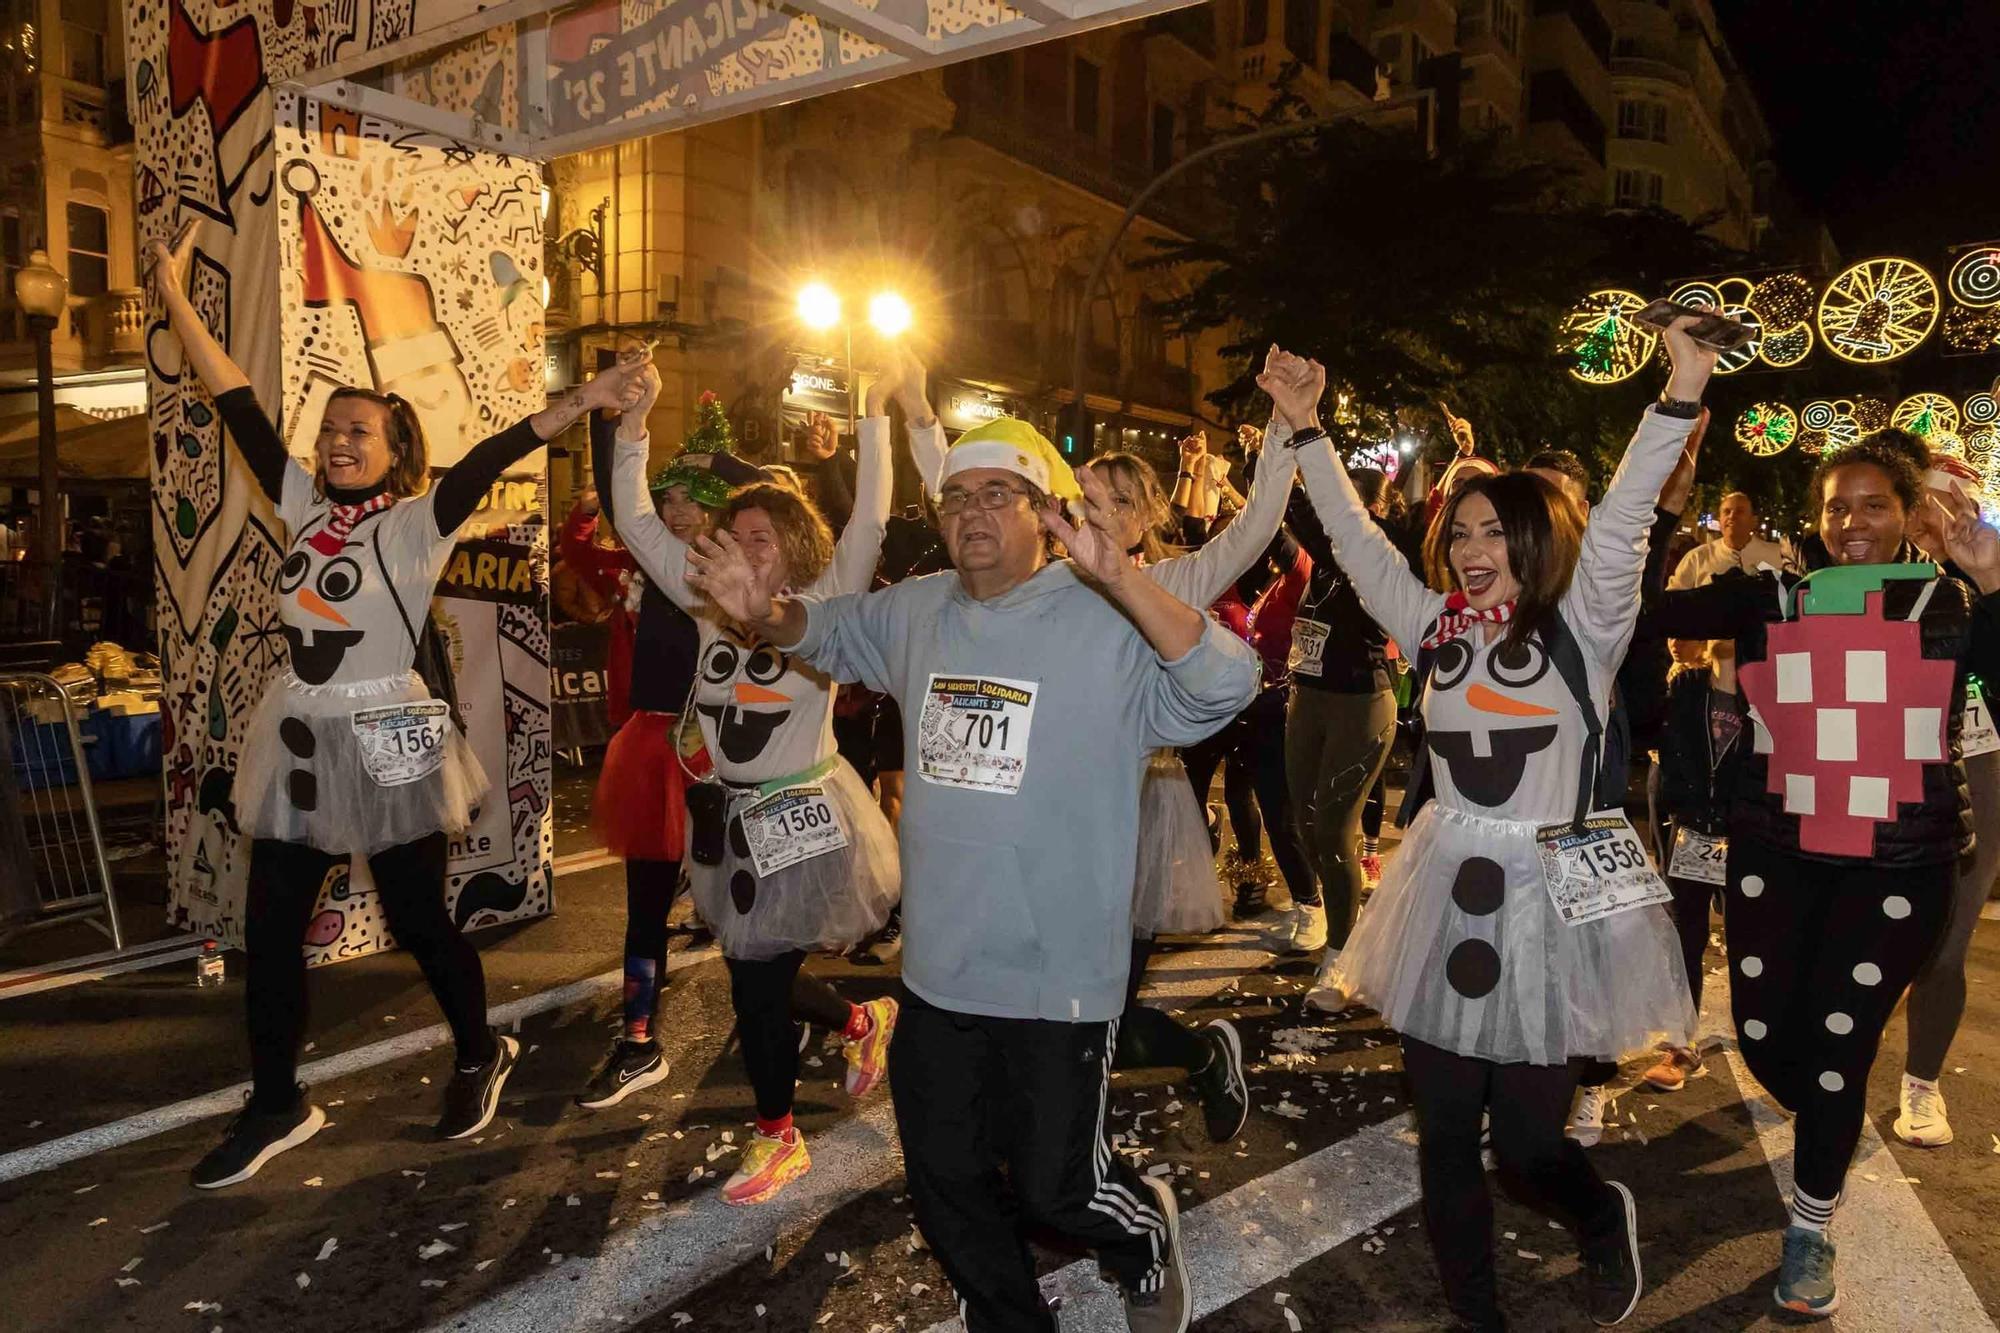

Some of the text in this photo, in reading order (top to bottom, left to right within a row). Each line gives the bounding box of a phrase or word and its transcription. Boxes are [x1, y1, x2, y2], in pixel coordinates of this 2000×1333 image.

[953, 698, 989, 708] ALICANTE
[982, 683, 1029, 703] SOLIDARIA
[964, 713, 1011, 751] 701
[778, 803, 832, 836] 1560
[1580, 839, 1646, 878] 1558
[1699, 844, 1729, 863] 24
